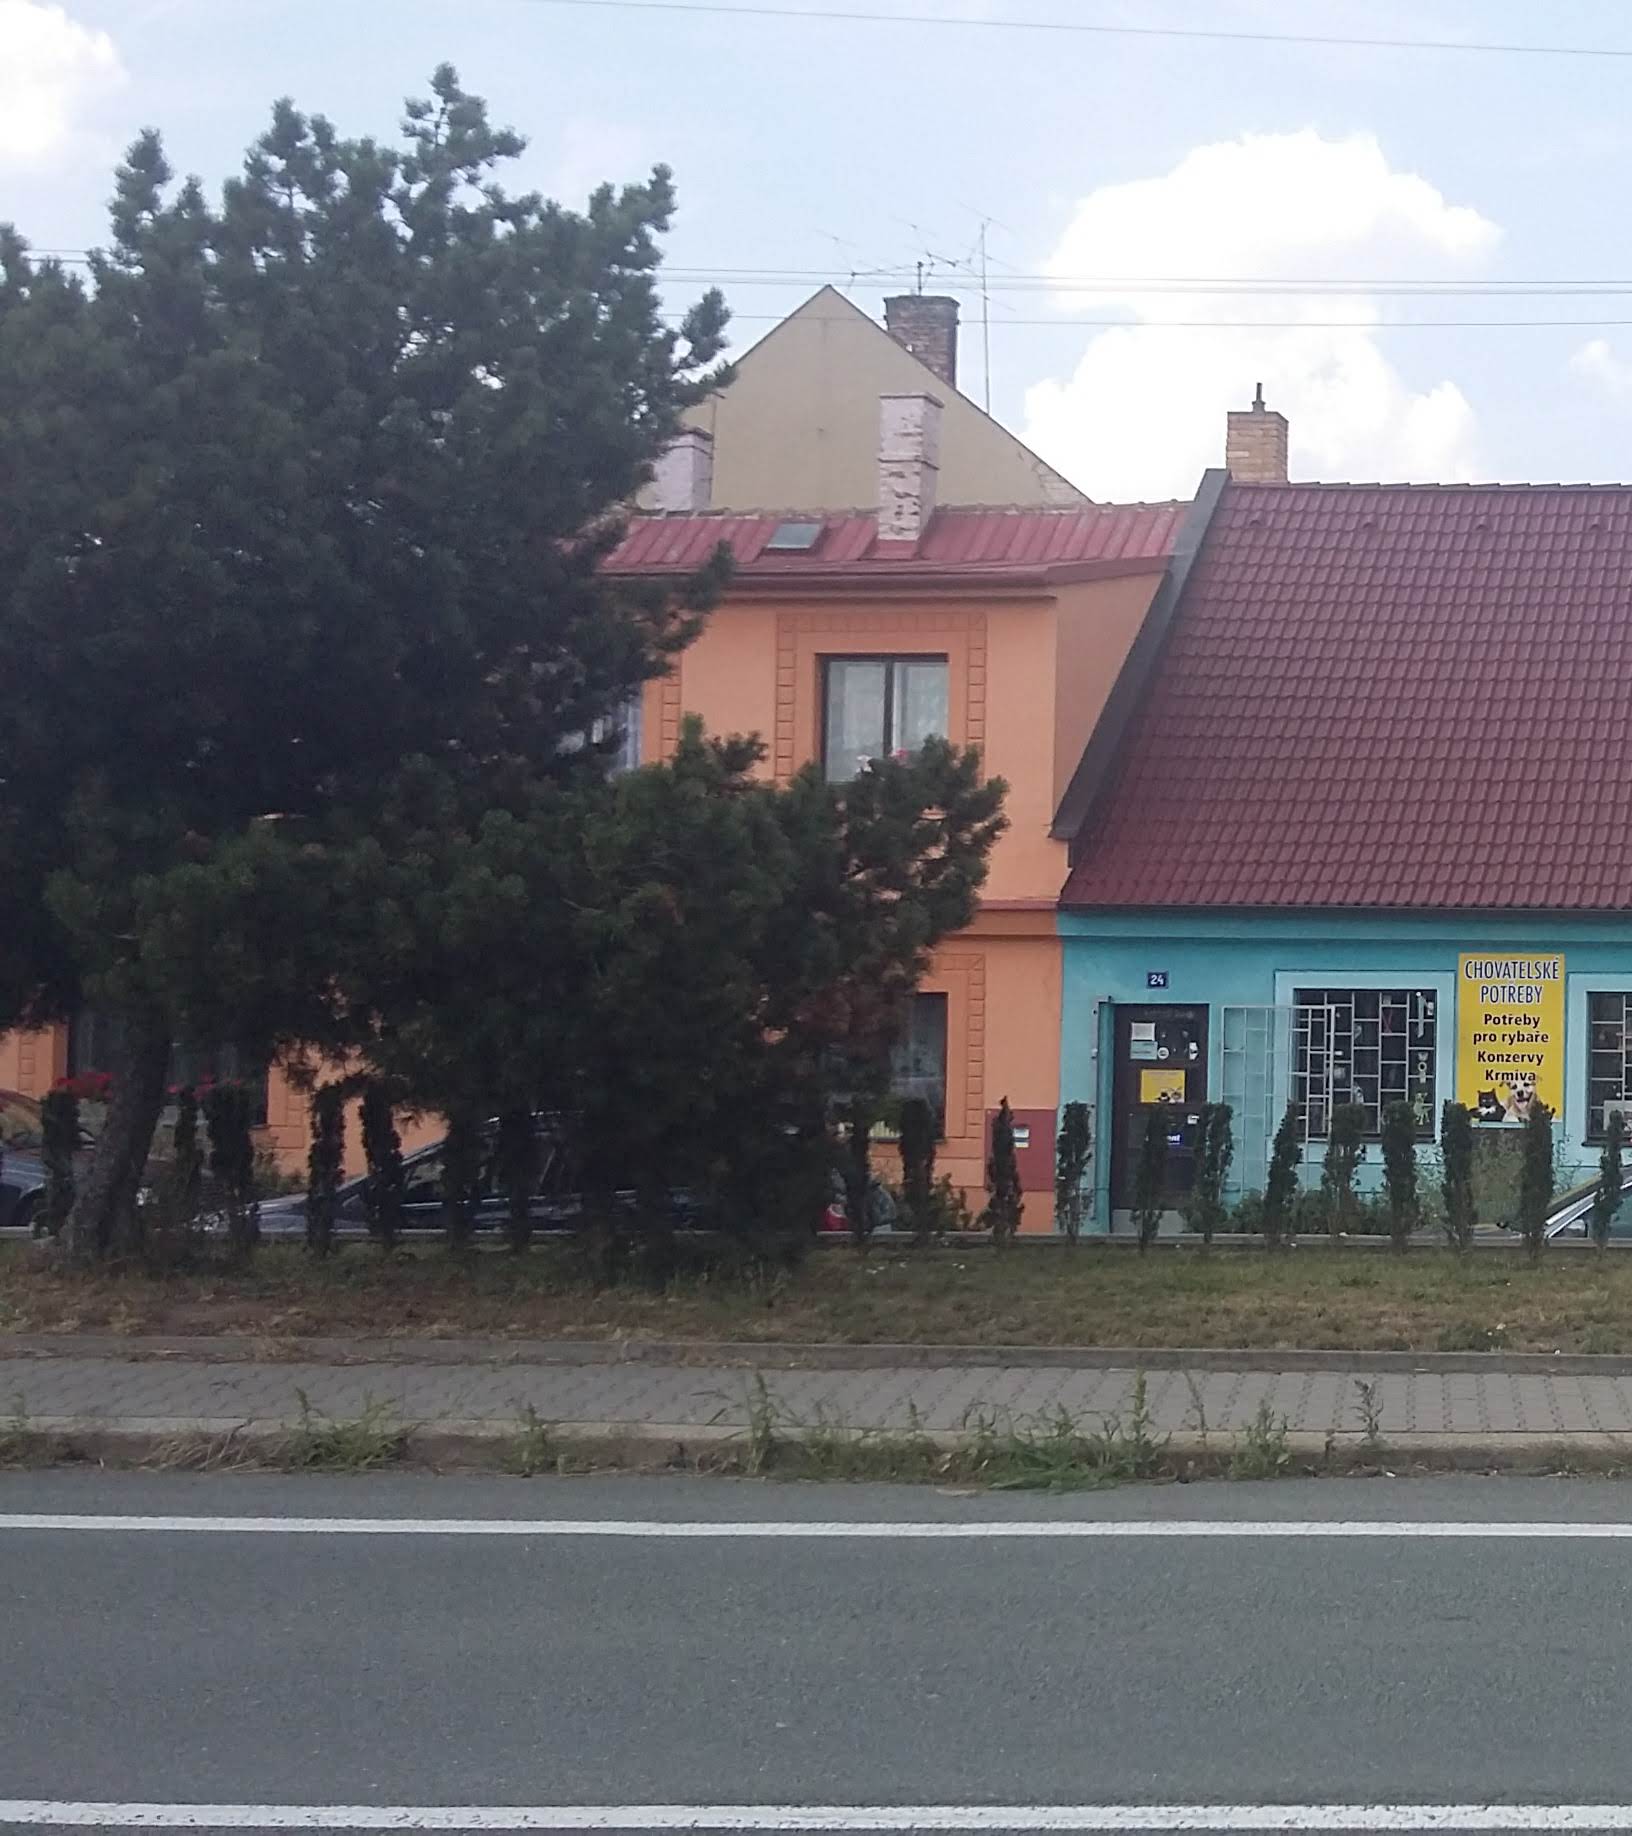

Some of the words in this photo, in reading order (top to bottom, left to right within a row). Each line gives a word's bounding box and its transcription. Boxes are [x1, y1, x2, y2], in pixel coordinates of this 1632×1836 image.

[1465, 957, 1560, 980] CHOVATELSKÉ
[1150, 975, 1164, 985] 24
[1481, 980, 1543, 1004] POTŘEBY
[1484, 1013, 1541, 1028] Potřeby
[1473, 1032, 1497, 1045] pro
[1501, 1030, 1549, 1046] rybaře
[1477, 1051, 1544, 1066] Konzervy
[1485, 1069, 1537, 1082] Krmiva
